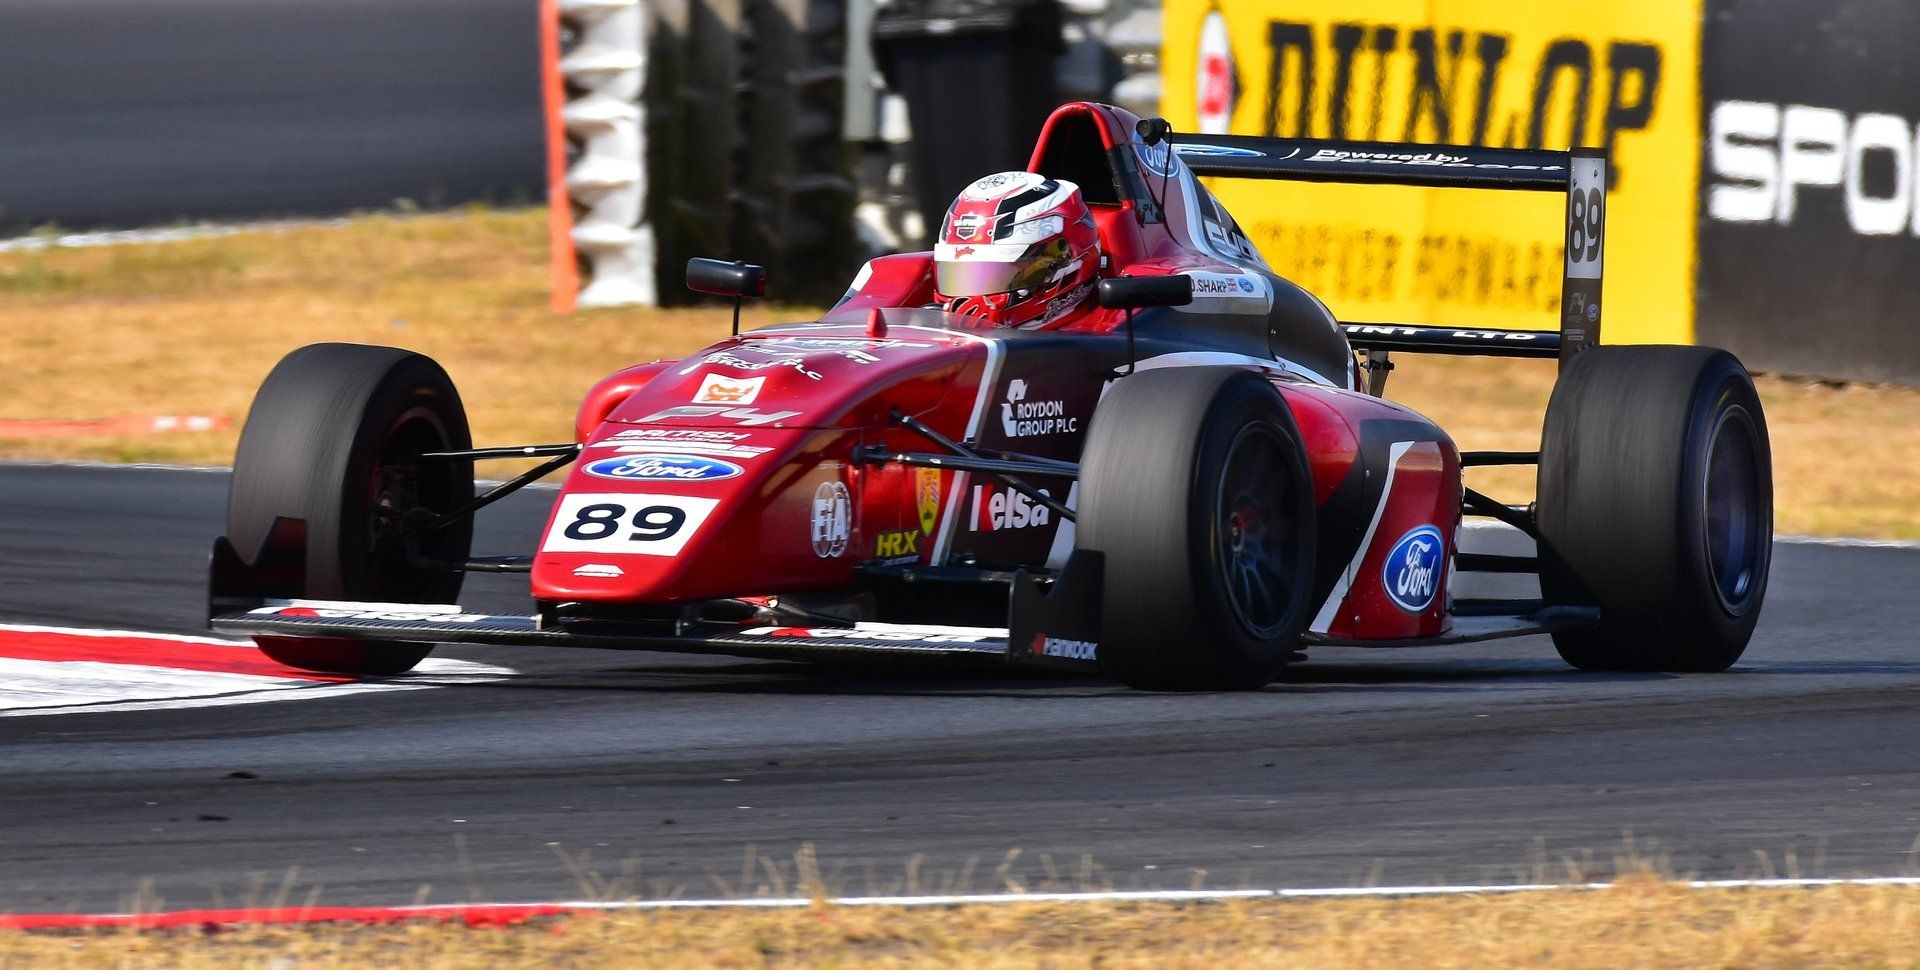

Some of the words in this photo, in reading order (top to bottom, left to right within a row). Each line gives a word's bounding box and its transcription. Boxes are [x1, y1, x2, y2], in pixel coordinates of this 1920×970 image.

[1262, 20, 1662, 191] DUNLOP
[1317, 149, 1431, 162] Powered
[1437, 153, 1468, 164] by
[1708, 100, 1920, 237] SPO
[1569, 187, 1602, 264] 89
[1452, 330, 1536, 341] LTD
[1017, 401, 1064, 418] ROYDON
[613, 429, 752, 441] BRITISH
[1017, 420, 1056, 437] GROUP
[1056, 417, 1077, 434] PLC
[611, 457, 710, 478] Ford
[564, 503, 687, 542] 89
[813, 498, 847, 542] FIA
[876, 530, 919, 556] HRX
[1397, 539, 1437, 597] Ford
